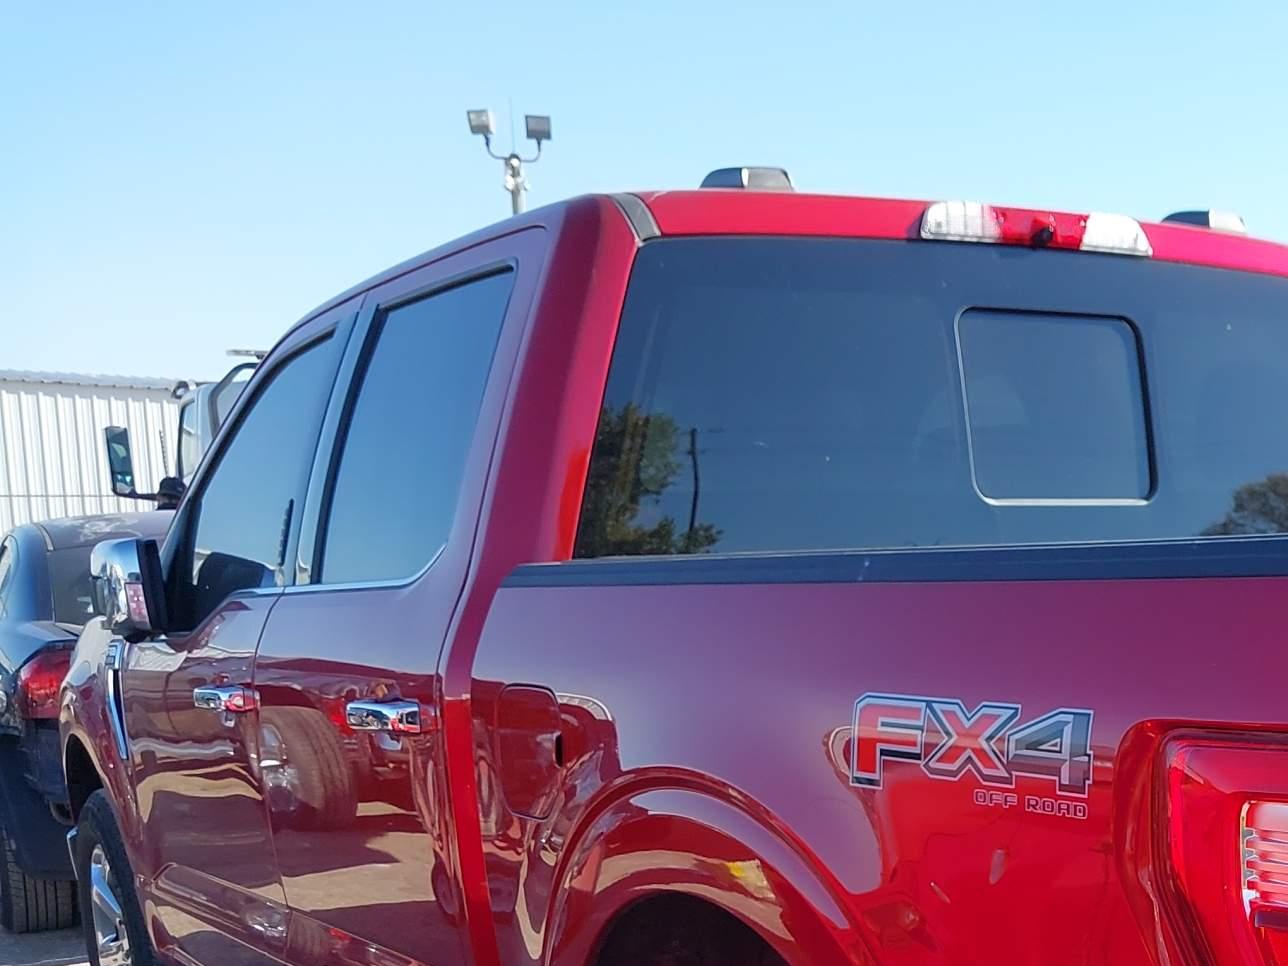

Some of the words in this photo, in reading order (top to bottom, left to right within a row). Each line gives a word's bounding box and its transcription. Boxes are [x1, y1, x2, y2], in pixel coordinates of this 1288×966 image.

[850, 692, 1093, 797] FX4
[973, 788, 1018, 809] OFF
[1024, 797, 1089, 820] ROAD
